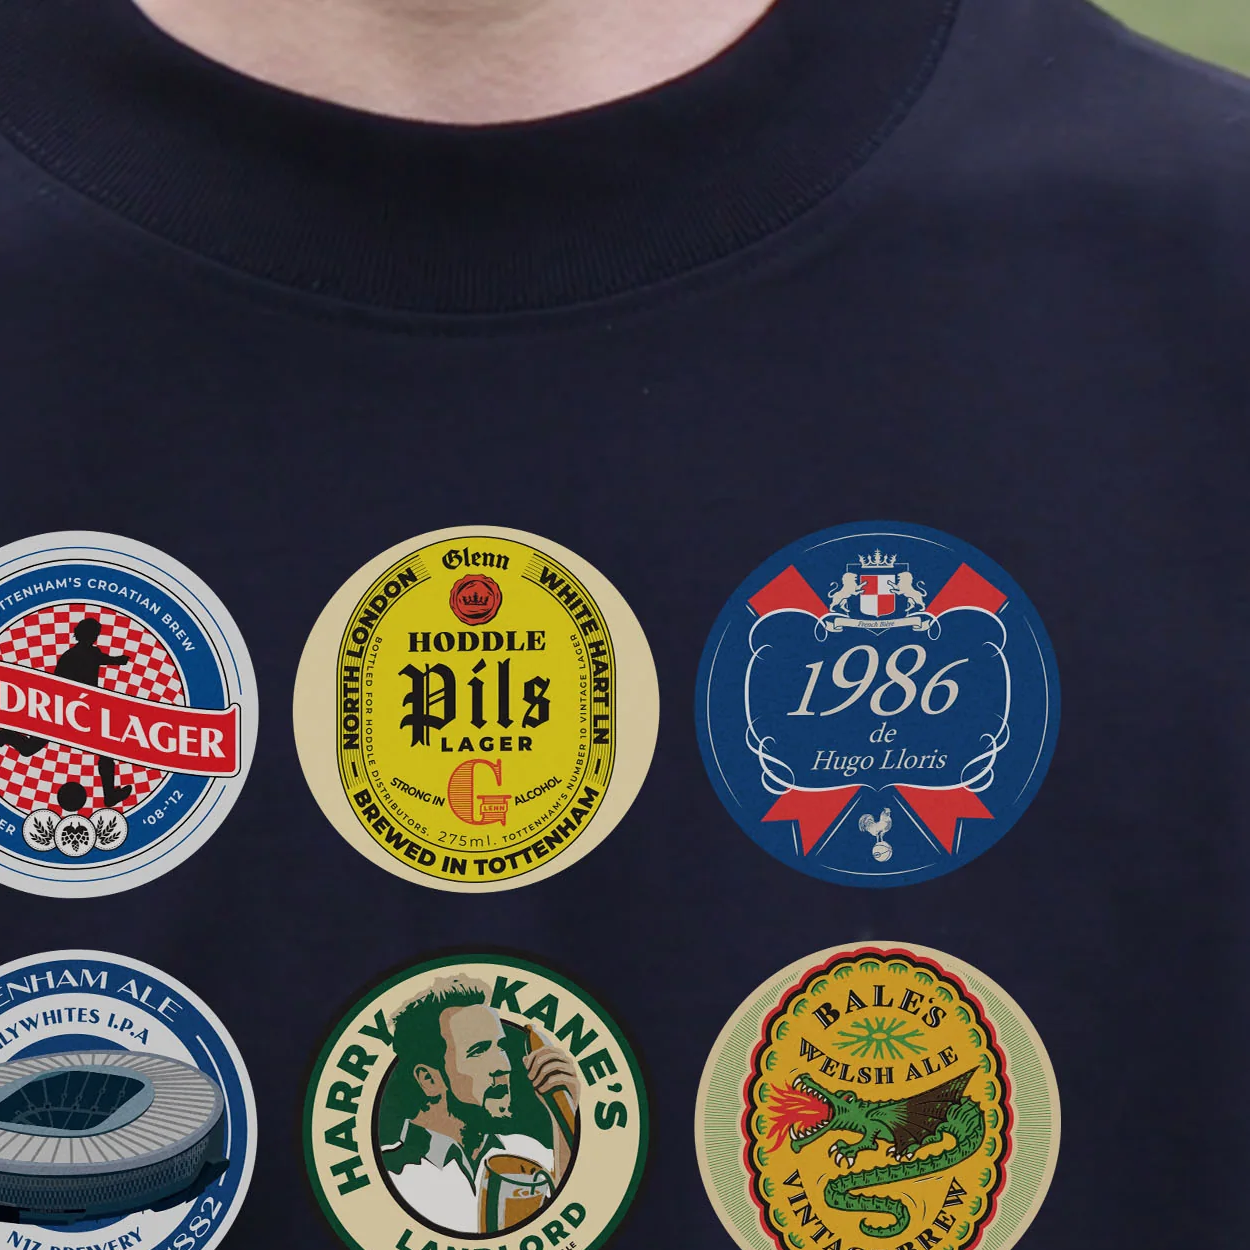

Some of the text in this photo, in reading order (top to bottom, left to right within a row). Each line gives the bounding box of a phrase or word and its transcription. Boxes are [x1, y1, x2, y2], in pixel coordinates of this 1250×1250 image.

[442, 547, 510, 570] Glenn
[88, 579, 160, 615] CROATIAN
[161, 614, 195, 652] BREW
[343, 567, 418, 750] NORTH LONDON
[366, 636, 382, 686] BOTTLED
[408, 630, 546, 653] HODDLE
[540, 566, 609, 744] WHITE HART LN
[570, 634, 586, 668] LAGER
[787, 644, 969, 717] 1986
[101, 707, 226, 758] LAGER
[366, 720, 375, 765] HODDLE
[441, 736, 532, 752] LAGER
[580, 728, 586, 738] 10
[869, 722, 897, 743] de
[567, 744, 586, 790] NUMBER
[810, 748, 948, 777] Hugo Lloris
[372, 770, 429, 836] DISTRIBUTORS.
[390, 777, 445, 806] STRONG IN
[515, 776, 562, 805] ALCOHOL
[354, 786, 599, 875] BREWED IN TOTTENHAM
[502, 793, 567, 842] TOTTENHAM'S
[118, 978, 184, 1023] ALE
[811, 985, 947, 1030] BALE'S
[107, 1013, 149, 1045] I.P.A
[800, 1038, 958, 1085] WELSH ALE
[324, 975, 628, 1196] HARRY KANE'S
